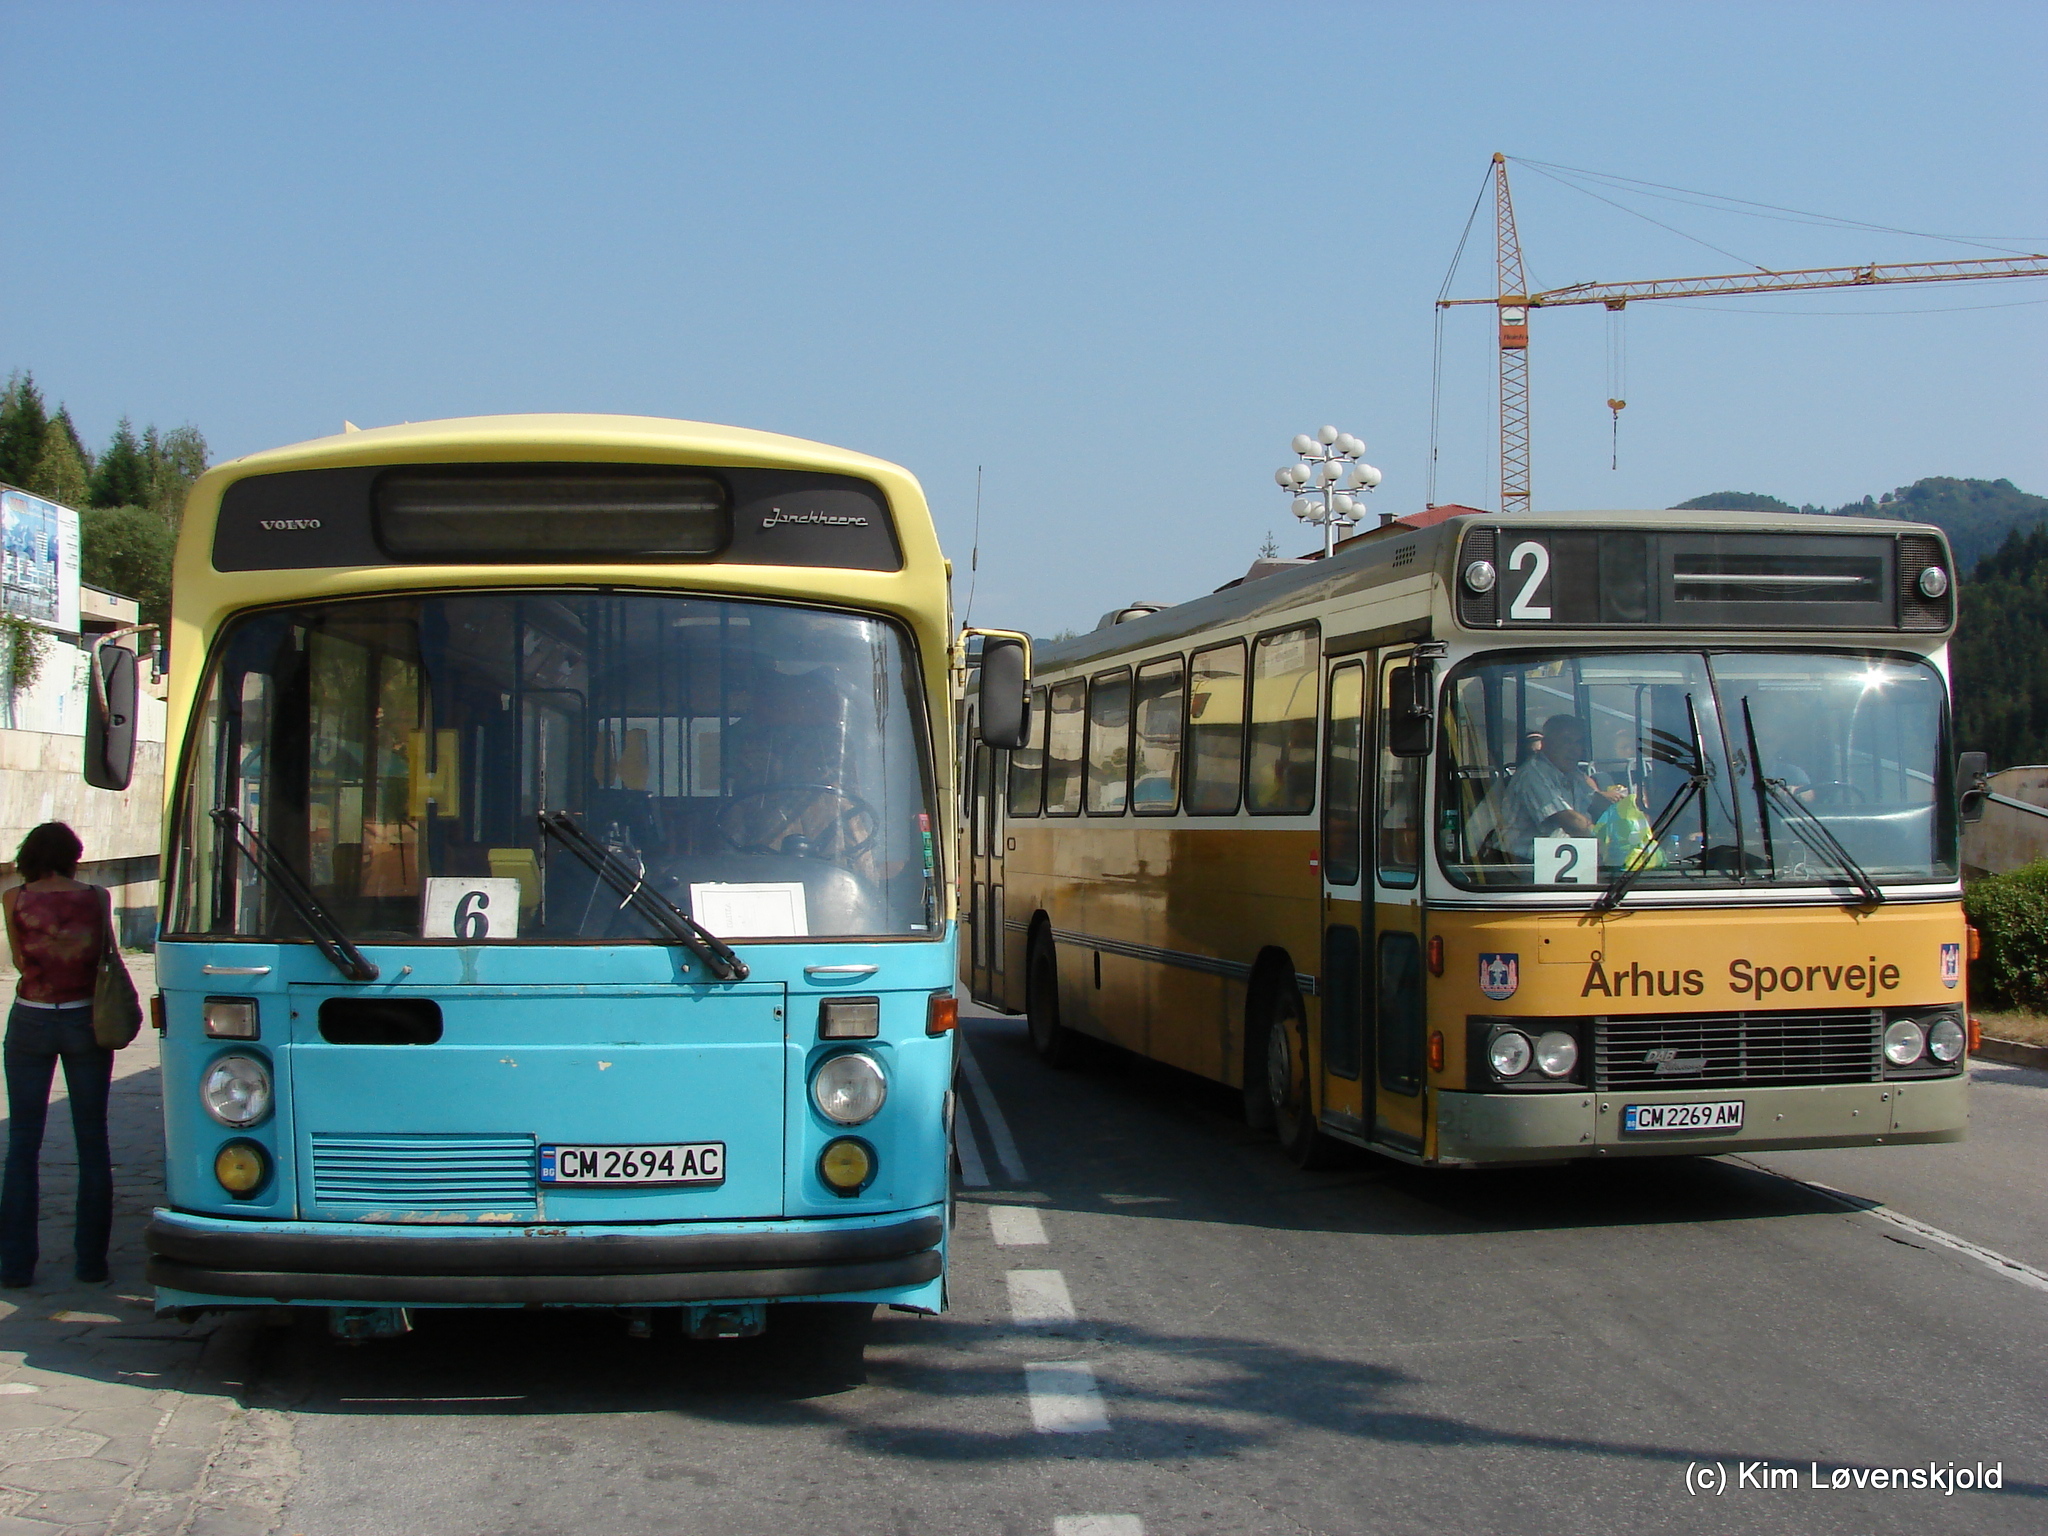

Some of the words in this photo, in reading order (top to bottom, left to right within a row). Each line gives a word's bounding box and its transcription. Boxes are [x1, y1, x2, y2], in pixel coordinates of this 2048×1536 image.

[260, 519, 321, 530] VOLVO
[762, 507, 869, 528] Jonckheere
[1509, 541, 1551, 619] 2
[1554, 843, 1578, 883] 2
[454, 890, 490, 939] 6
[1580, 950, 1705, 997] Århus
[1728, 956, 1901, 1001] Sporveje
[1647, 1050, 1675, 1062] DAB
[1639, 1109, 1663, 1126] CM
[1667, 1107, 1712, 1126] 2269
[1716, 1105, 1739, 1124] AM
[542, 1168, 555, 1177] BG
[560, 1150, 598, 1178] CM
[604, 1150, 675, 1178] 2694
[681, 1148, 718, 1176] AC
